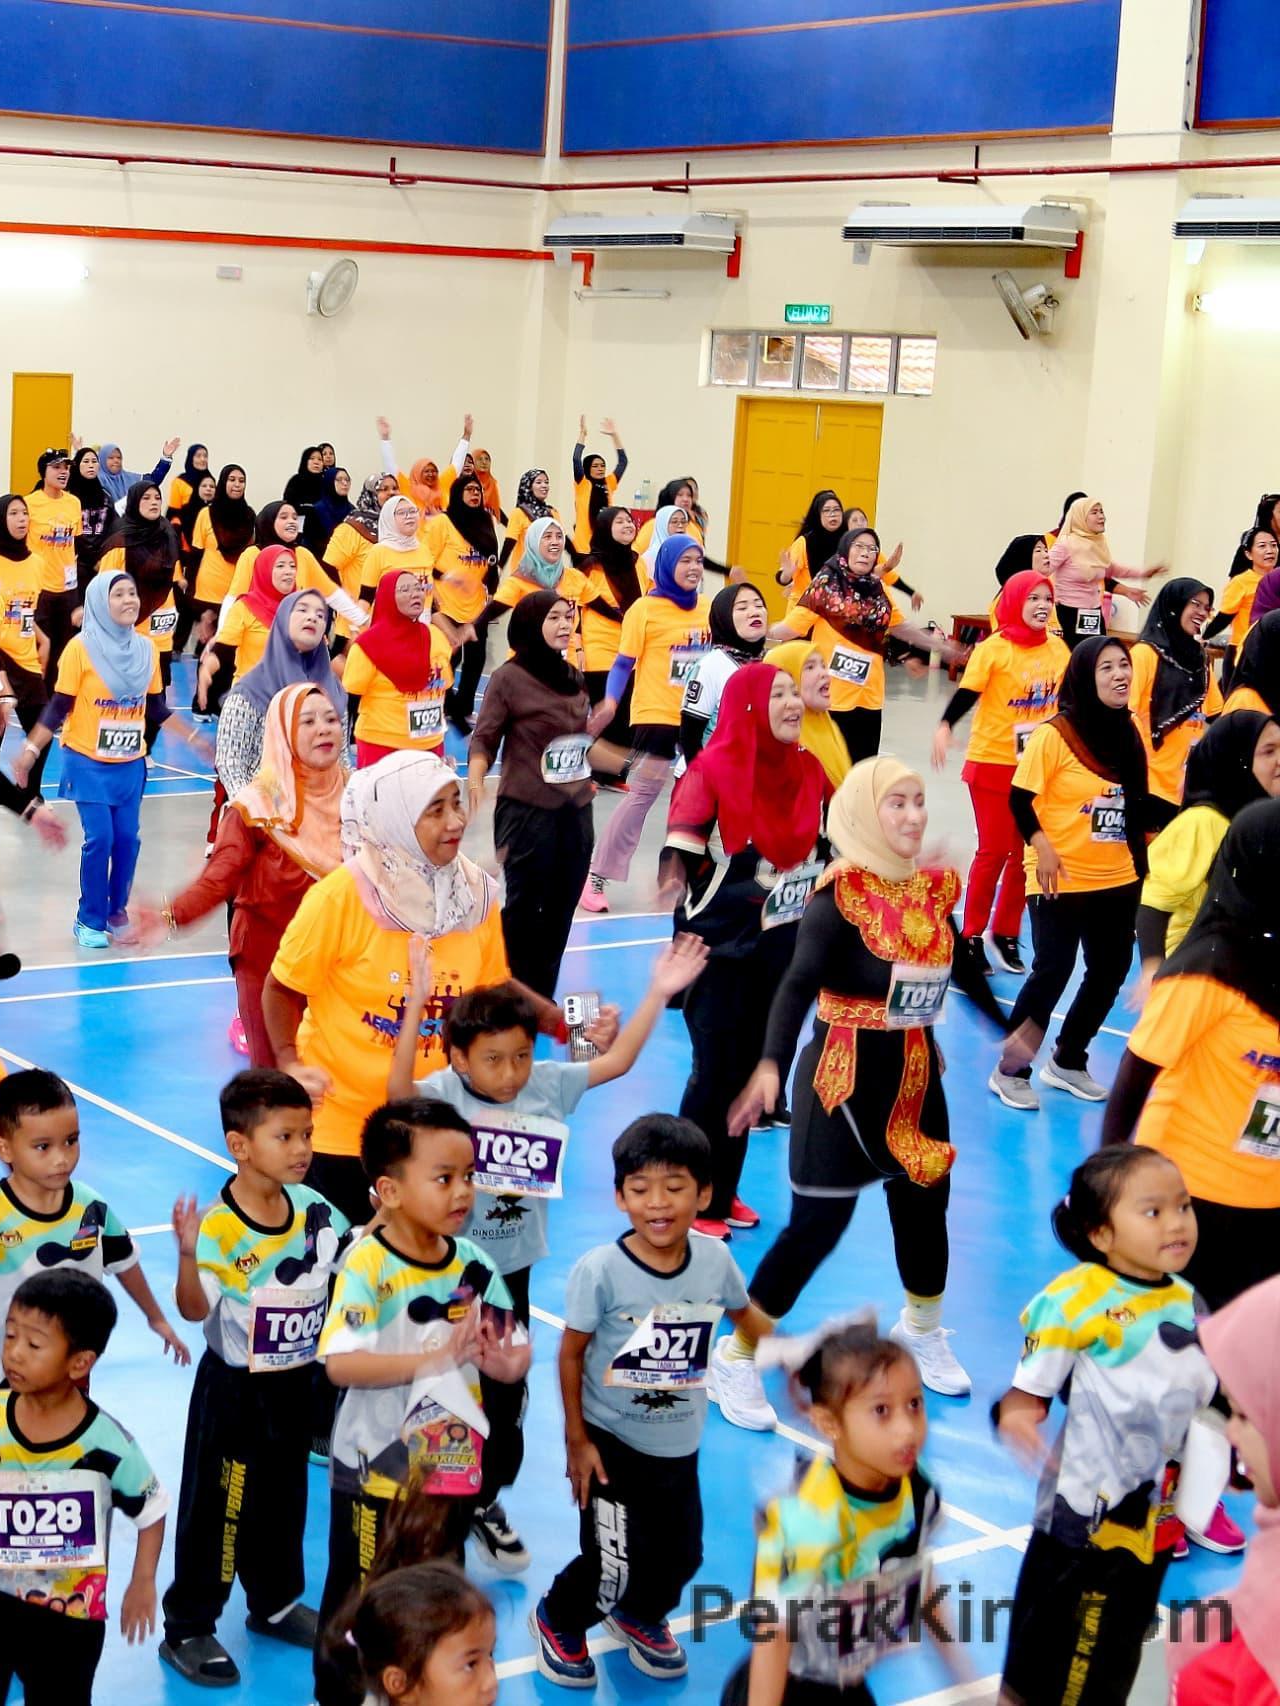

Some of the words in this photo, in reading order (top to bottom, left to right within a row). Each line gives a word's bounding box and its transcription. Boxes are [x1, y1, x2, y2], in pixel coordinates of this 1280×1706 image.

[835, 654, 867, 674] T057
[105, 730, 140, 747] T072
[476, 1131, 548, 1170] T026
[266, 1310, 324, 1342] T005
[634, 1328, 701, 1359] 027
